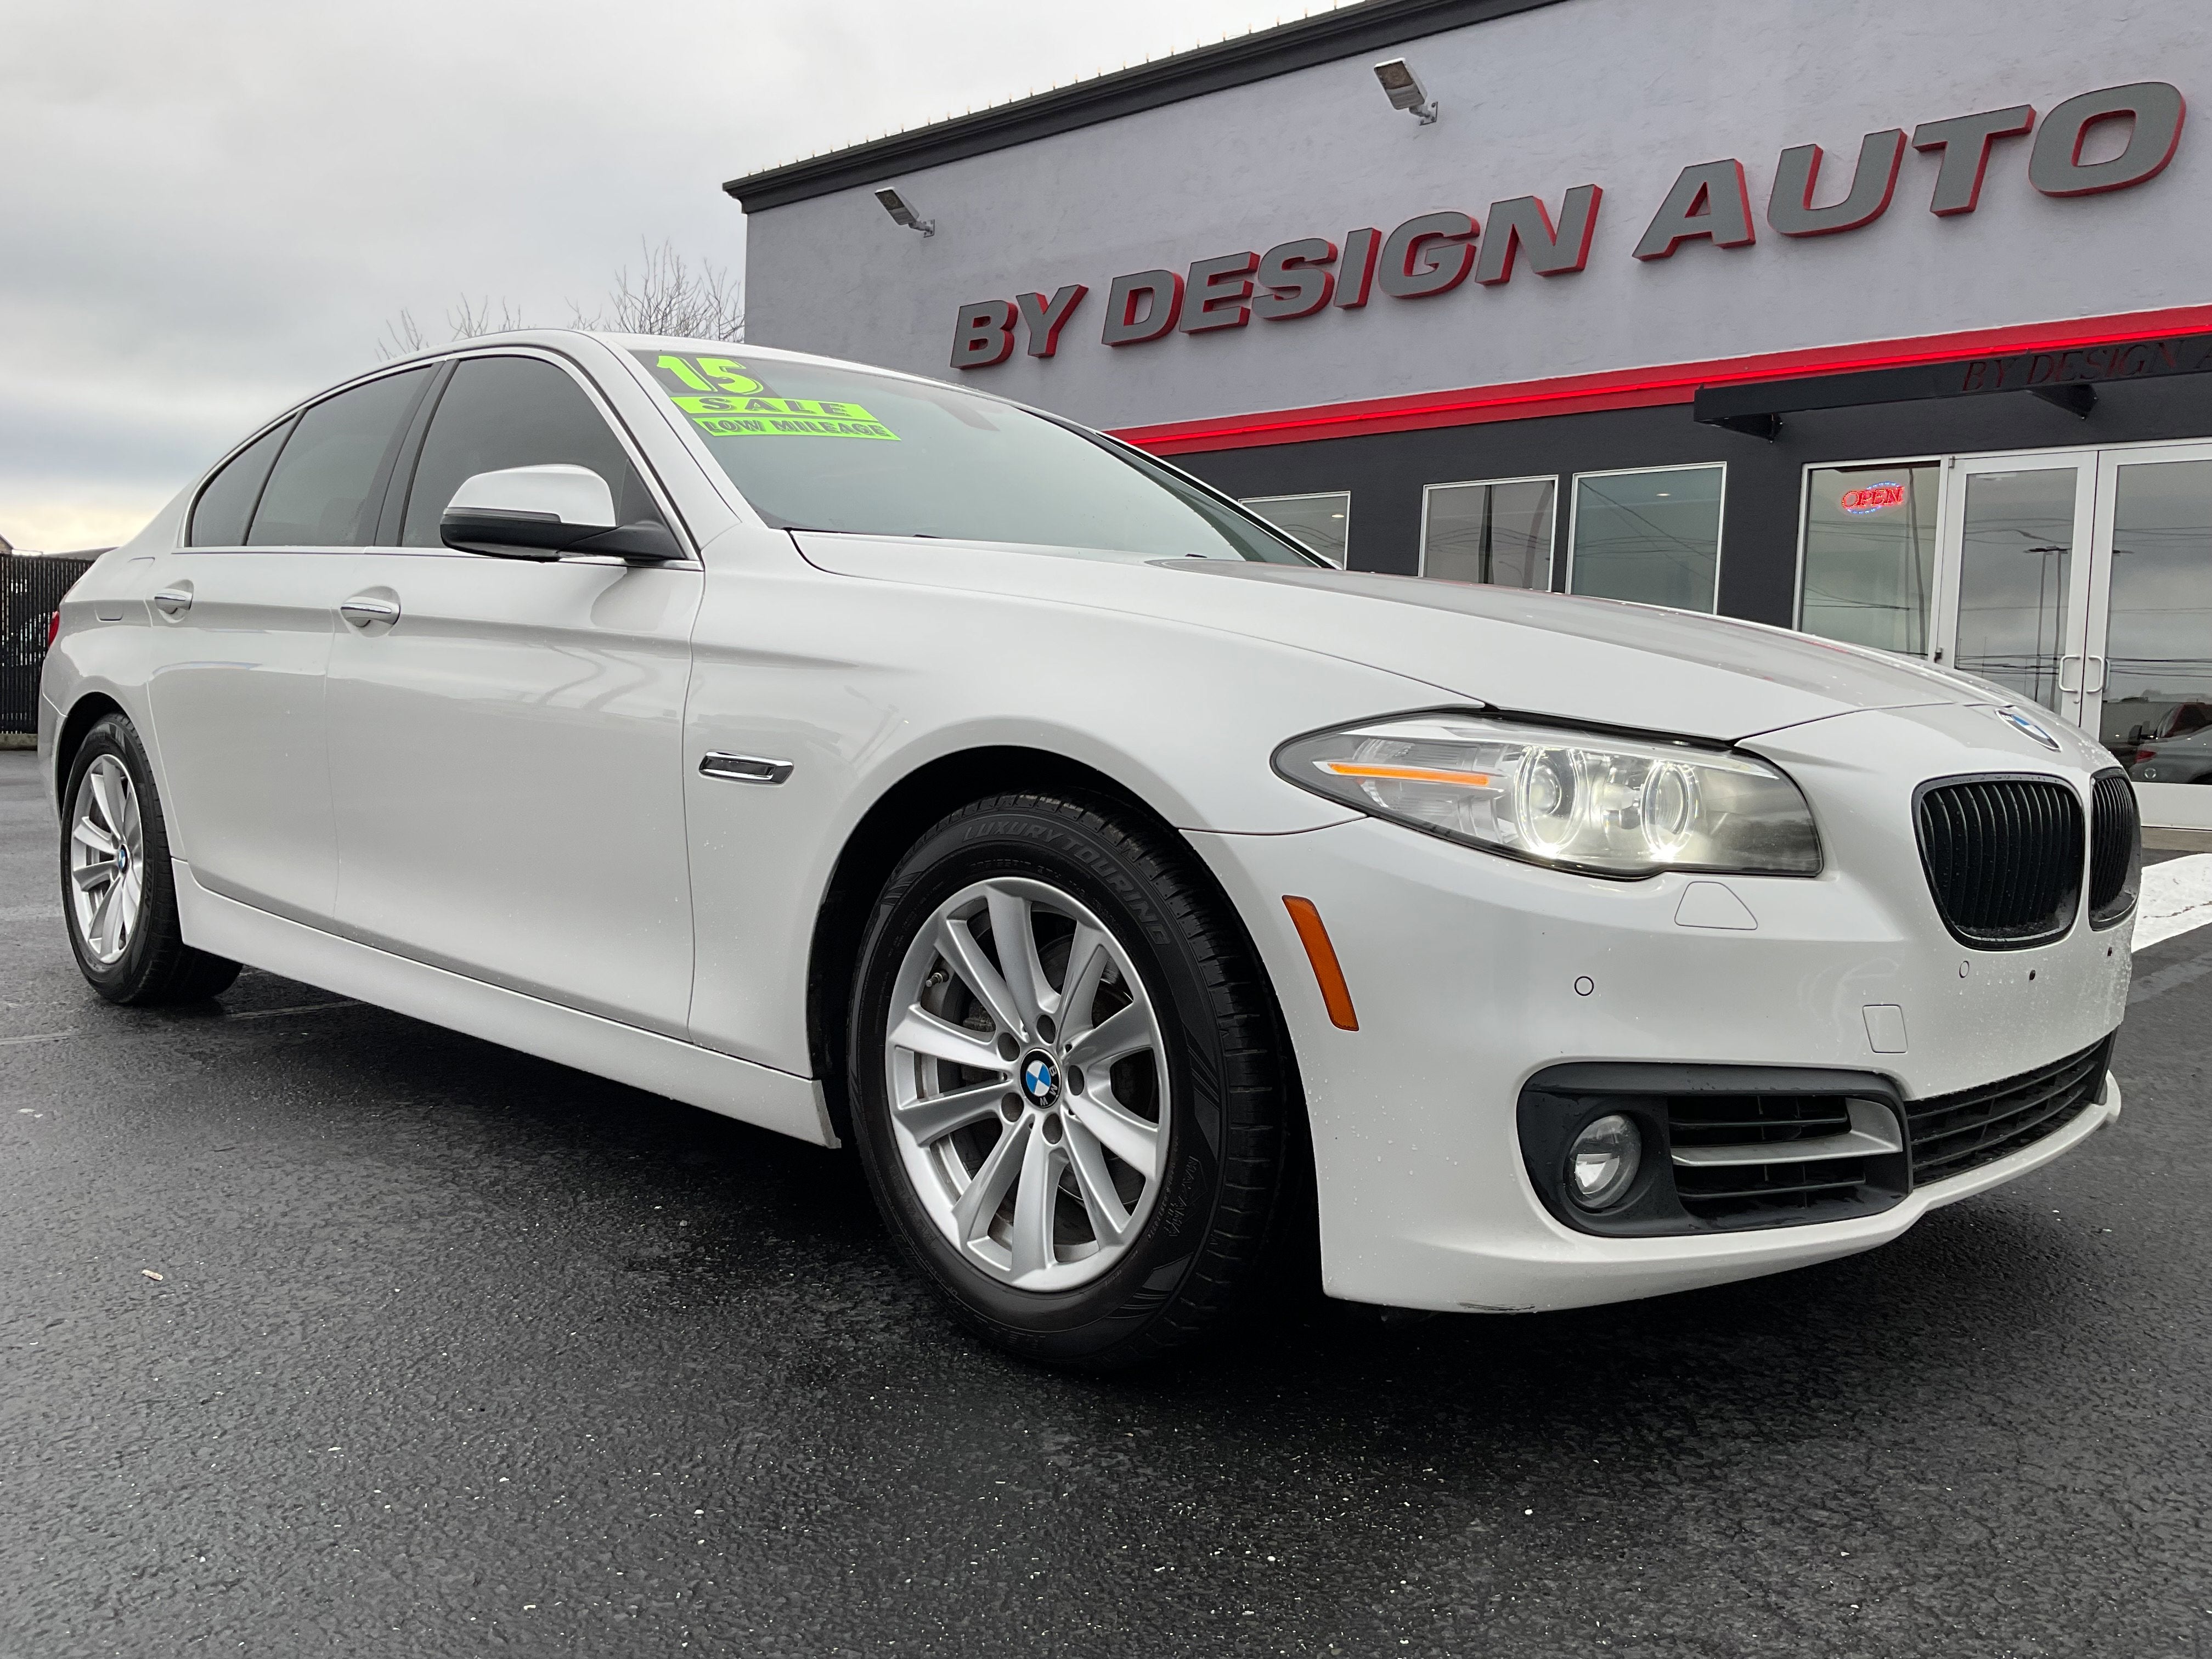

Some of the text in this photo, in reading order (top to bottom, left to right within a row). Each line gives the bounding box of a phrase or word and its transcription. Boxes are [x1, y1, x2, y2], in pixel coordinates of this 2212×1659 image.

[950, 81, 2186, 369] BY DESIGN AUTO
[657, 356, 764, 395] 15
[1962, 358, 2019, 391] BY
[2027, 341, 2185, 384] DESIGN
[699, 397, 853, 416] SALE
[702, 420, 891, 437] LOW MILEAGE
[1842, 487, 1905, 509] OPEN
[963, 821, 1065, 843] LUXURY
[1062, 838, 1171, 945] TOURING
[1040, 1065, 1058, 1106] BMW
